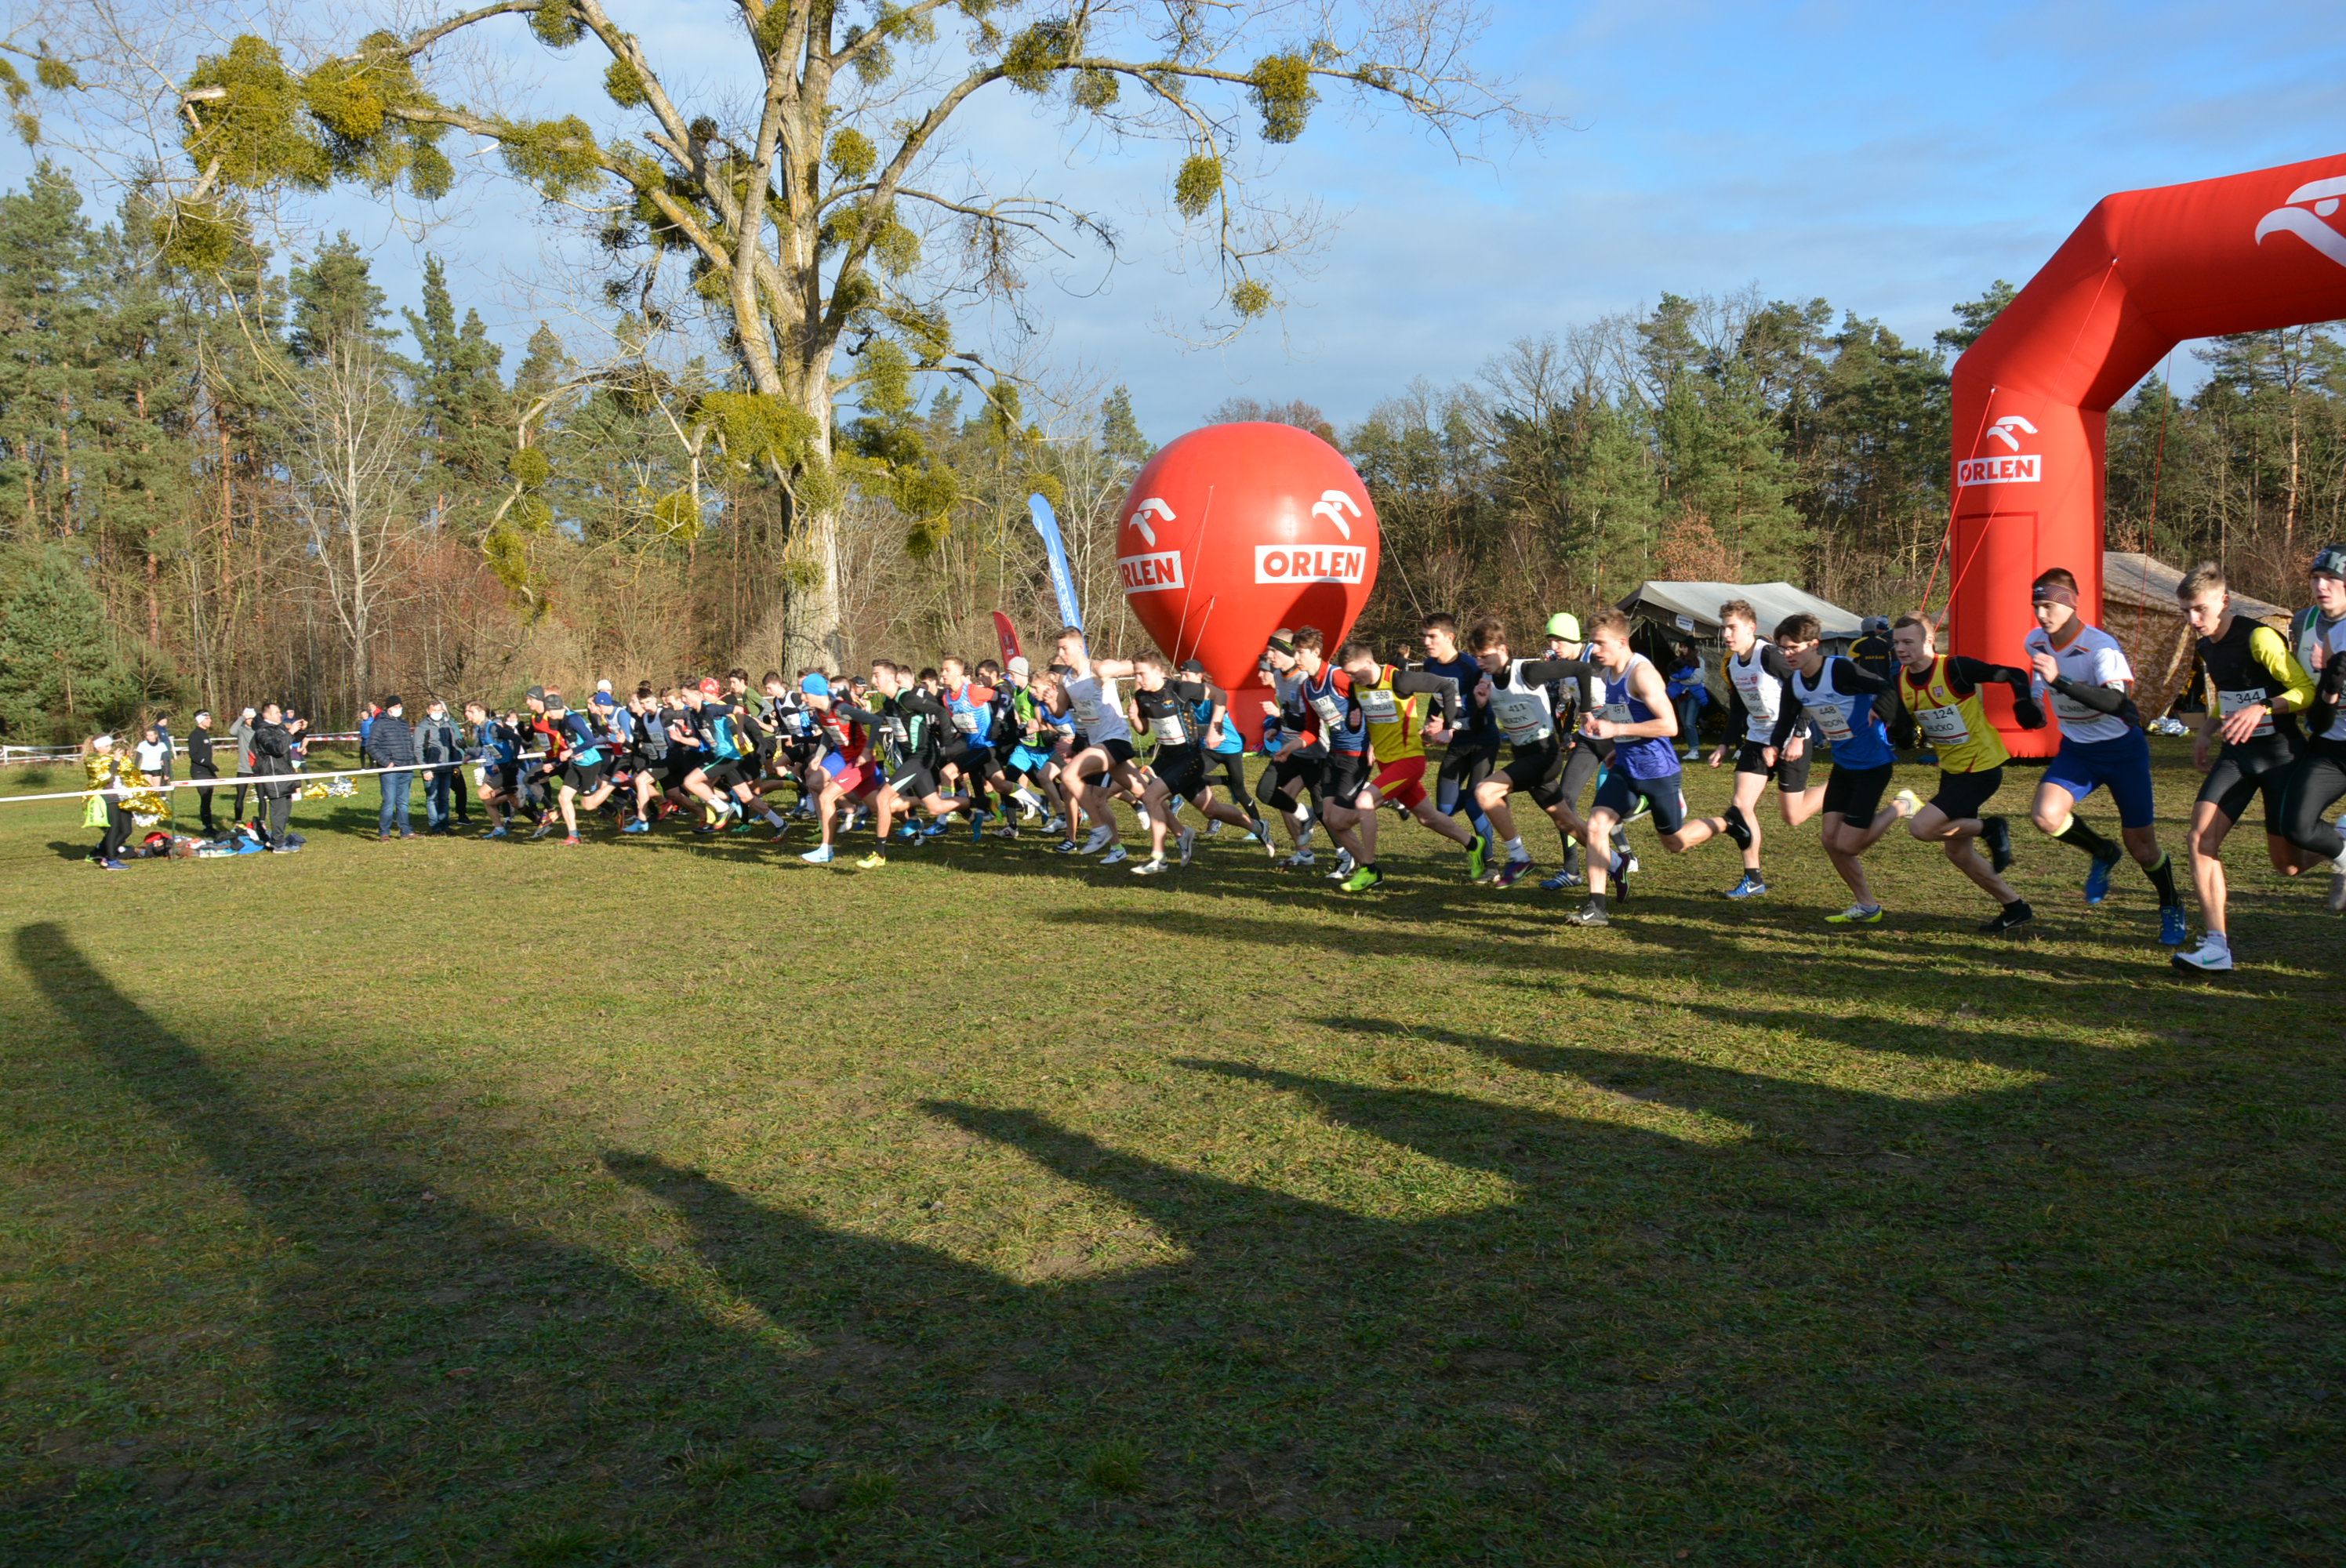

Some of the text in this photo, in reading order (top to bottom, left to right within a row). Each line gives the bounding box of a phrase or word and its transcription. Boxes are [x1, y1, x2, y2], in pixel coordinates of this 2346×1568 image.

[1960, 459, 2034, 482] ORLEN
[1118, 557, 1176, 588] RLEN
[1262, 551, 1361, 578] ORLEN
[2235, 691, 2261, 704] 344
[1508, 703, 1527, 712] 411
[1933, 707, 1955, 719] 124
